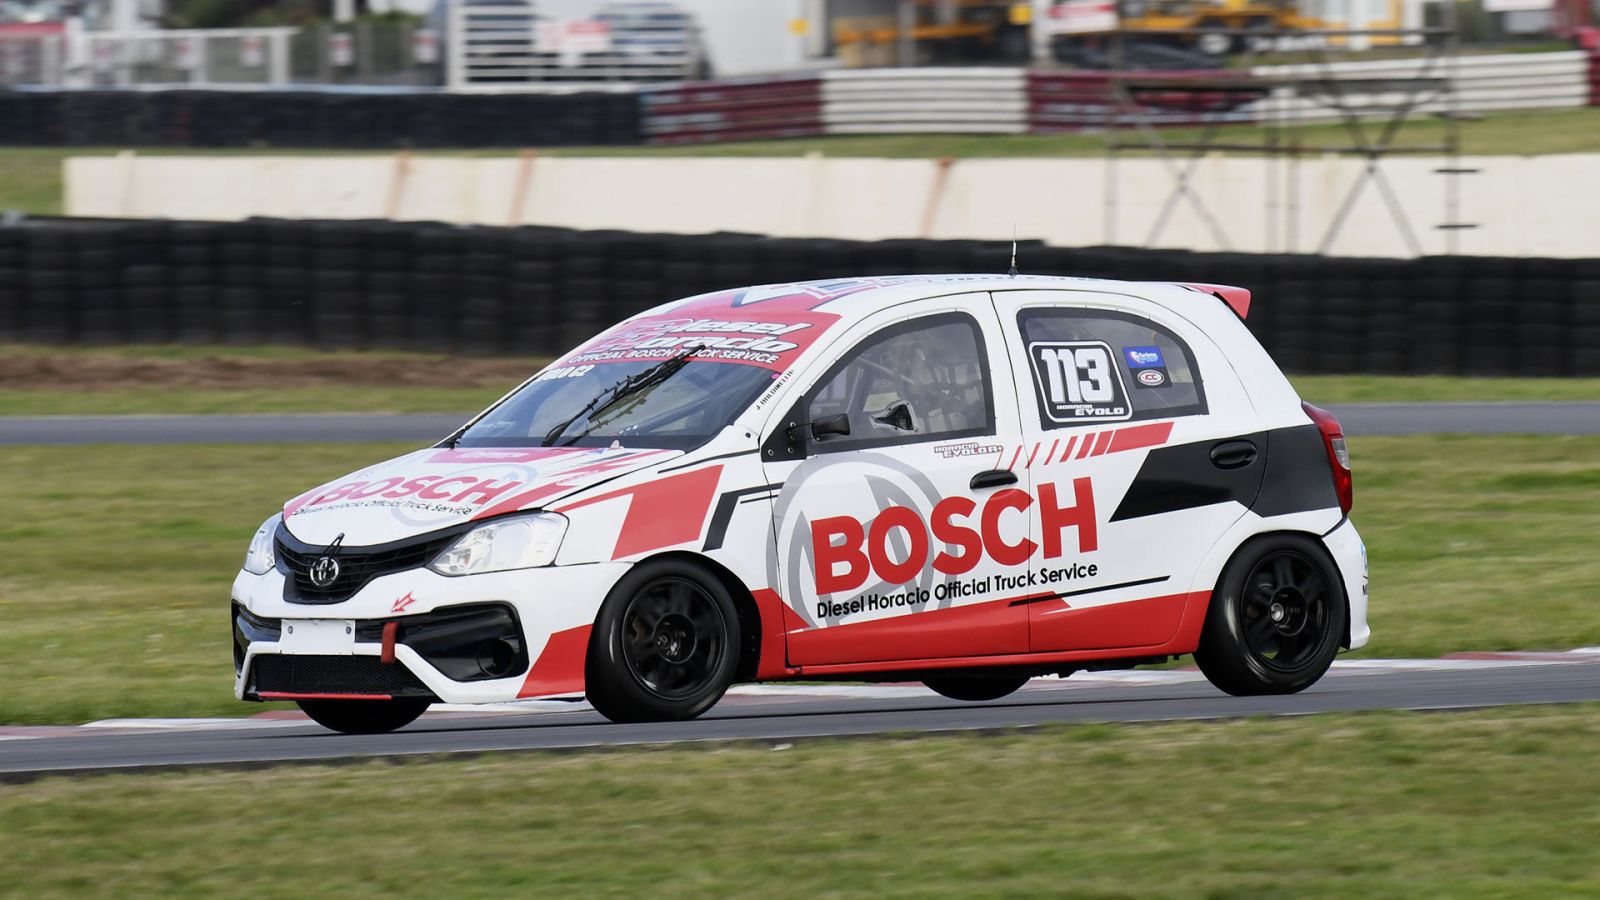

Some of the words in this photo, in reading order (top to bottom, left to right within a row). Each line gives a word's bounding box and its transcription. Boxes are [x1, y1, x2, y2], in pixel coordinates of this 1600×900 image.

[626, 348, 676, 358] BOSCH
[719, 350, 780, 364] SERVICE
[1041, 348, 1114, 403] 113
[1075, 407, 1124, 416] EVOLO
[311, 475, 522, 506] BOSCH
[810, 476, 1098, 595] BOSCH
[817, 596, 865, 618] Diesel
[869, 587, 931, 611] Horacio
[935, 576, 991, 601] Official
[995, 570, 1037, 593] Truck
[1040, 563, 1099, 585] Service
